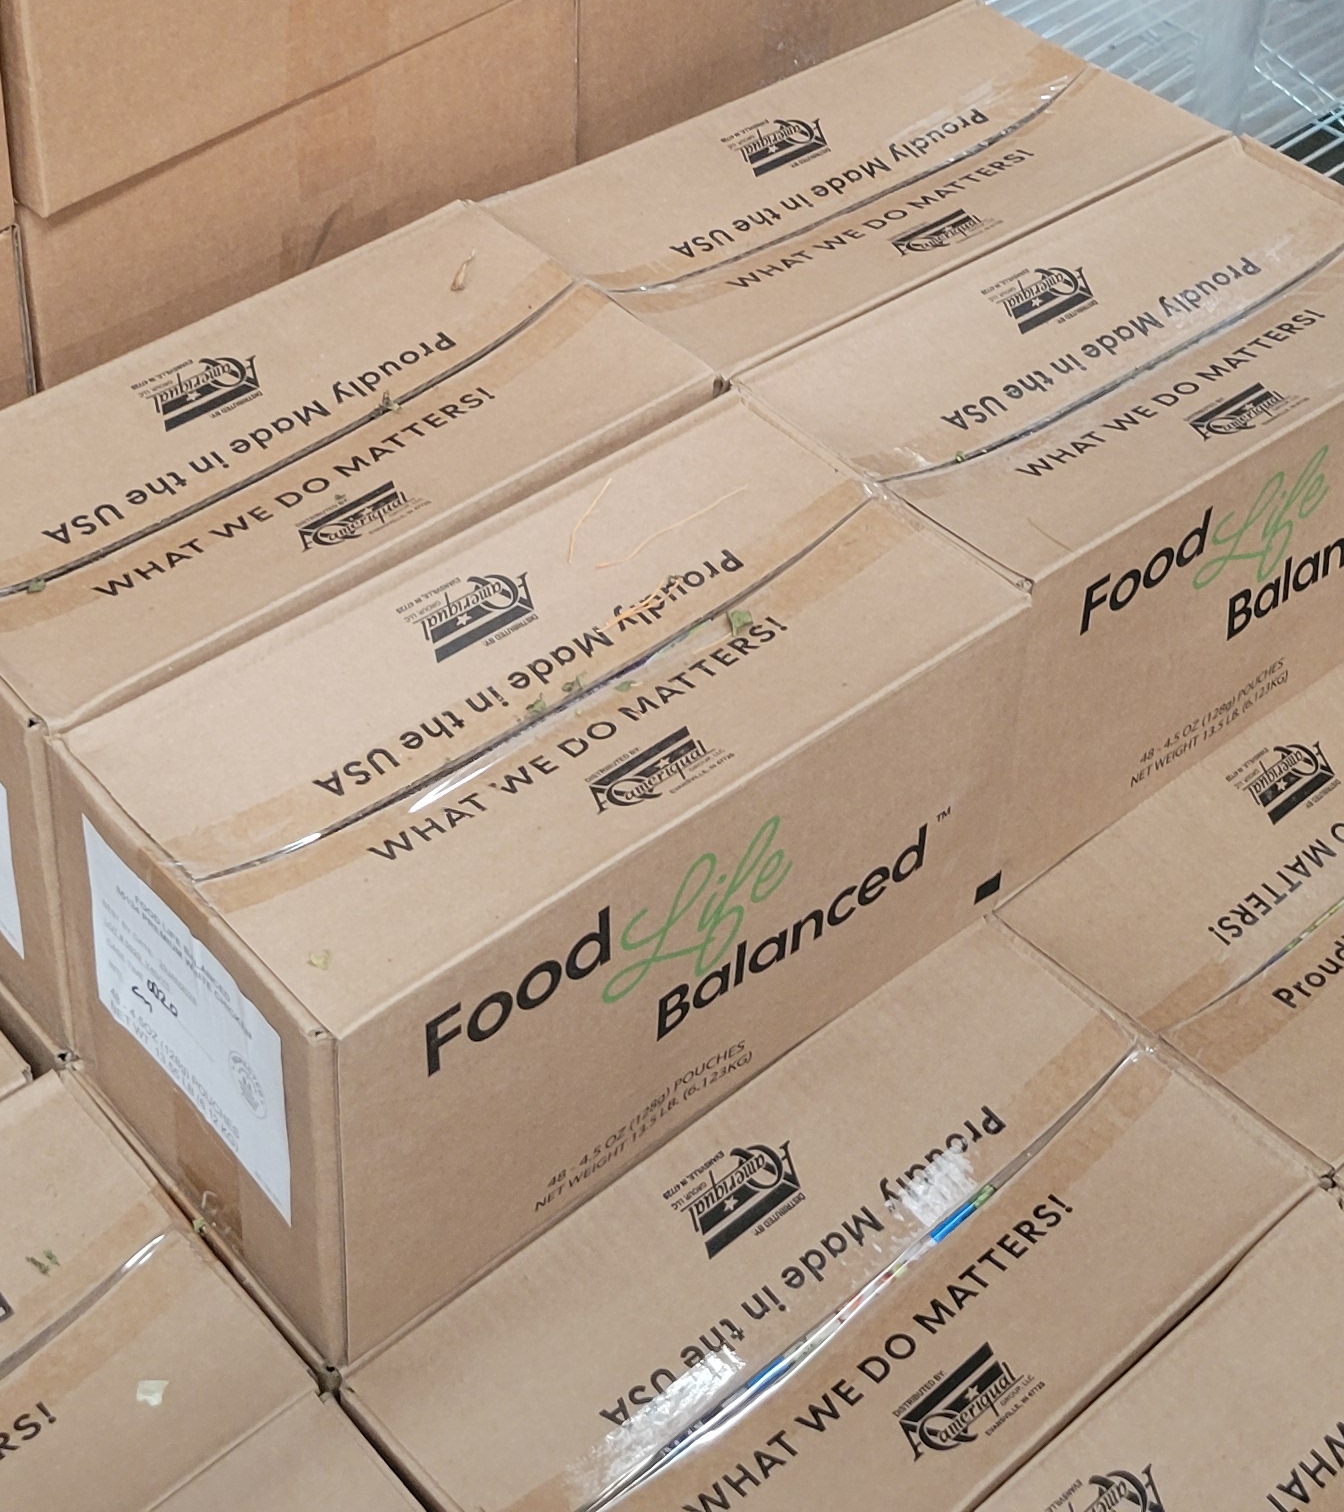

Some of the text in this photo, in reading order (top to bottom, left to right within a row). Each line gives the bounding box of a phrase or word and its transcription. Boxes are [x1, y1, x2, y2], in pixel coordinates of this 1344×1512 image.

[670, 108, 989, 259] Proudly Made in the USA
[725, 148, 1034, 290] WHAT WE DO MATTERS!
[941, 257, 1262, 431] Proudly Made in the USA
[1015, 309, 1326, 479] WHAT WE DO MATTERS!
[41, 332, 456, 546] Proudly Made in the USA
[93, 386, 496, 598] WHAT WE DO MATTERS!
[1080, 445, 1330, 636] Food Life
[468, 685, 510, 714] in
[508, 625, 615, 688] Made
[1140, 748, 1154, 763] 48
[1182, 719, 1199, 733] OZ
[1238, 657, 1284, 701] POUCHES
[312, 747, 400, 796] USA
[367, 616, 789, 862] WHAT WE DO MATTERS!
[399, 708, 466, 751] the
[1131, 763, 1153, 787] NET
[1155, 735, 1199, 770] WEIGHT
[426, 815, 793, 1077] Food Life
[656, 824, 929, 1042] Balanced
[1208, 838, 1337, 947] MATTERS!
[548, 1169, 566, 1187] 48
[606, 1126, 626, 1149] OZ
[674, 1040, 745, 1091] POUCHES
[535, 1185, 564, 1212] NET
[569, 1141, 625, 1188] WEIGHT
[741, 1289, 787, 1322] in
[781, 1205, 884, 1289] Made
[598, 1366, 679, 1428] USA
[682, 1193, 1074, 1512] WHAT WE DO MATTERS!
[893, 1379, 937, 1417] DISTRIBUTED
